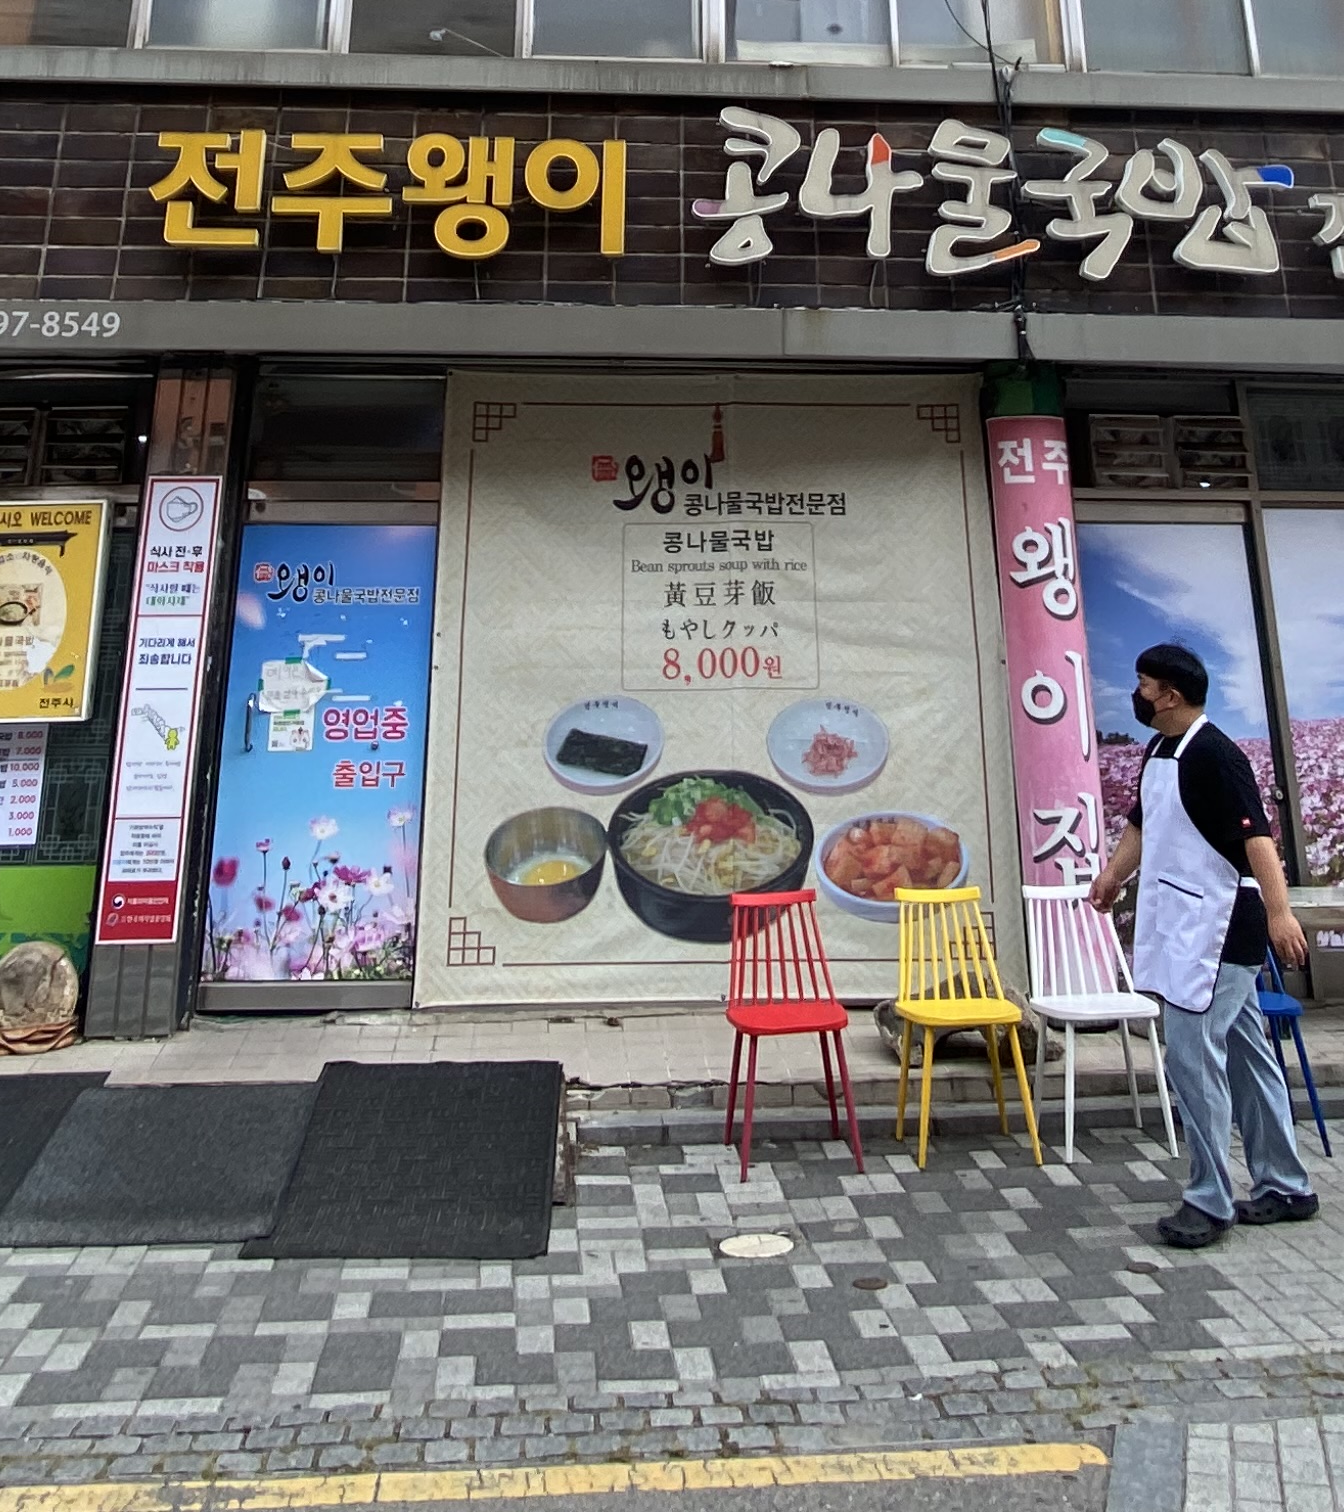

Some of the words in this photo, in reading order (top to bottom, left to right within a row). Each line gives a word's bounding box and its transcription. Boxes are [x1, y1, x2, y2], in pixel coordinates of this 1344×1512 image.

[148, 128, 626, 260] 전주왱이
[690, 104, 1296, 282] 콩나물국밥
[997, 438, 1069, 485] 전주
[613, 453, 716, 514] 왱이
[683, 491, 847, 516] 콩나물국밥전문점
[31, 510, 93, 527] WELCOME
[150, 545, 173, 558] 식사
[663, 529, 775, 554] 콩나물국밥
[146, 561, 180, 573] 마스크
[183, 561, 205, 573] 착용
[631, 559, 663, 574] Bean
[667, 560, 715, 575] sprouts
[719, 561, 748, 574] soup
[752, 558, 780, 571] with
[784, 559, 807, 571] rice
[268, 562, 336, 602] 왱이
[313, 587, 420, 605] 콩나물국밥전문점
[661, 618, 780, 640] もやしクッパ
[138, 637, 176, 649] 기다리게
[177, 637, 196, 649] 해서
[138, 653, 192, 666] 죄송합니다
[662, 646, 783, 686] 8,000원
[39, 696, 75, 710] 전주시
[323, 707, 409, 742] 영업중
[332, 759, 406, 788] 출입구
